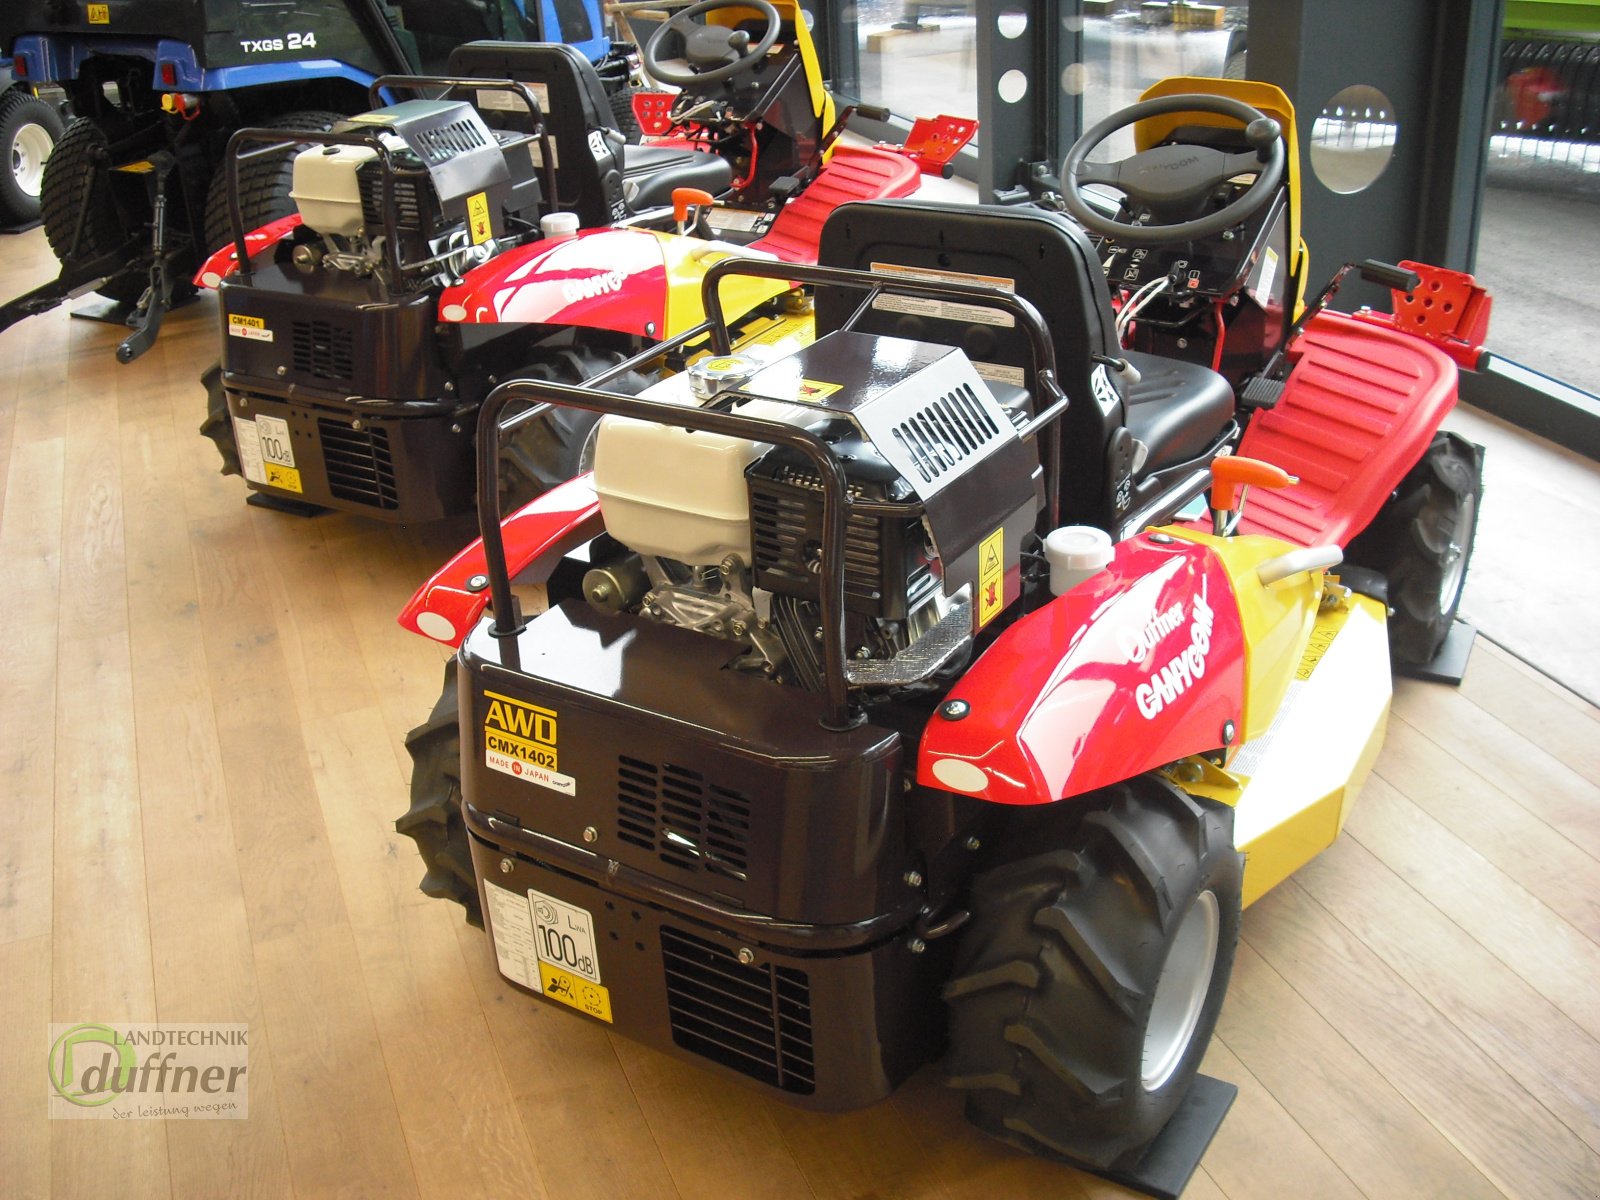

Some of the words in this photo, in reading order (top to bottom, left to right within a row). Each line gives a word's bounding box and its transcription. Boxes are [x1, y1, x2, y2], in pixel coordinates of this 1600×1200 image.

[240, 39, 283, 52] TXGS
[287, 32, 317, 49] 24
[232, 316, 260, 327] CM1401
[1135, 573, 1214, 720] CANYCOM
[485, 700, 557, 745] AWD
[488, 736, 555, 768] CMX1402
[489, 756, 509, 768] MADE
[513, 764, 521, 773] IN
[525, 769, 549, 782] JAPAN
[584, 1004, 602, 1015] STOP
